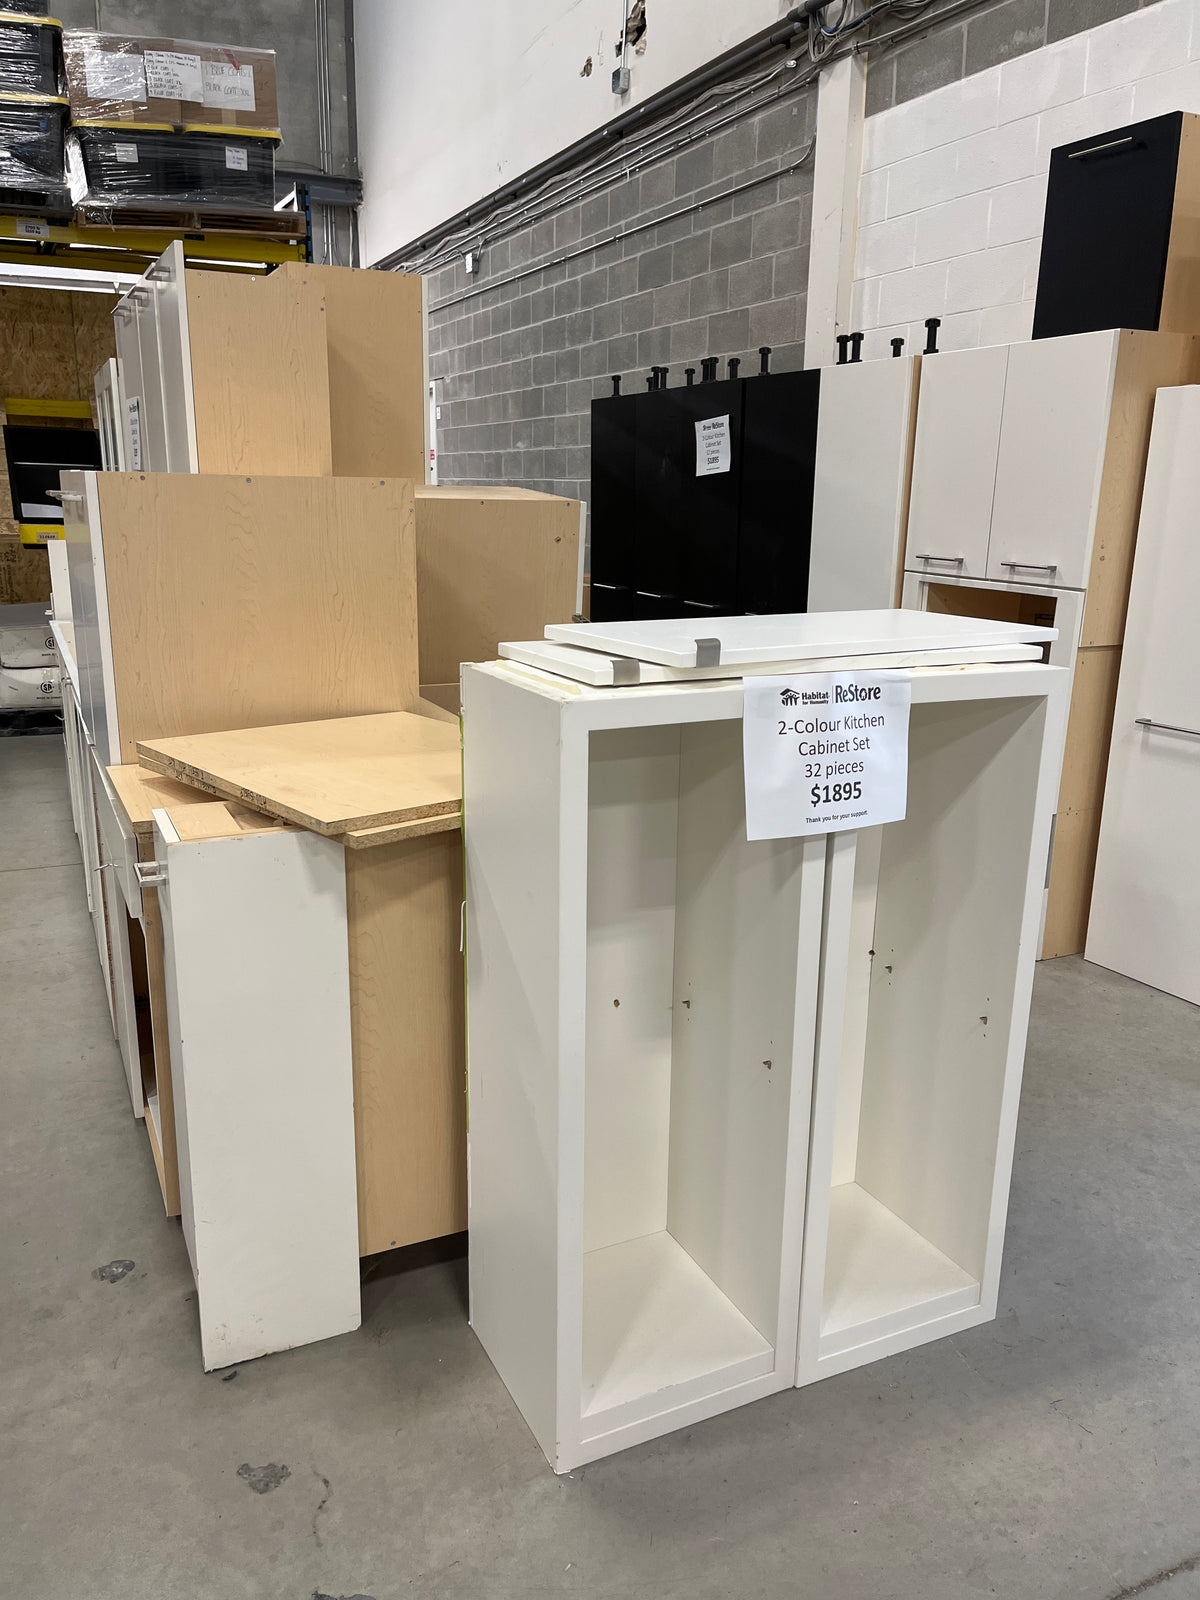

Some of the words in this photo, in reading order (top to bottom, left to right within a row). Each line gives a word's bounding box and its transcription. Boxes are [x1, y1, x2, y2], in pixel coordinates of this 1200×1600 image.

[801, 691, 829, 700] Habitat
[835, 683, 881, 703] ReStore
[778, 718, 841, 735] 2-Colour
[844, 713, 885, 730] Kitchen
[798, 739, 850, 756] Cabinet
[853, 736, 871, 750] Set
[804, 763, 822, 778] 32
[825, 761, 864, 779] pieces
[810, 781, 862, 808] $1895
